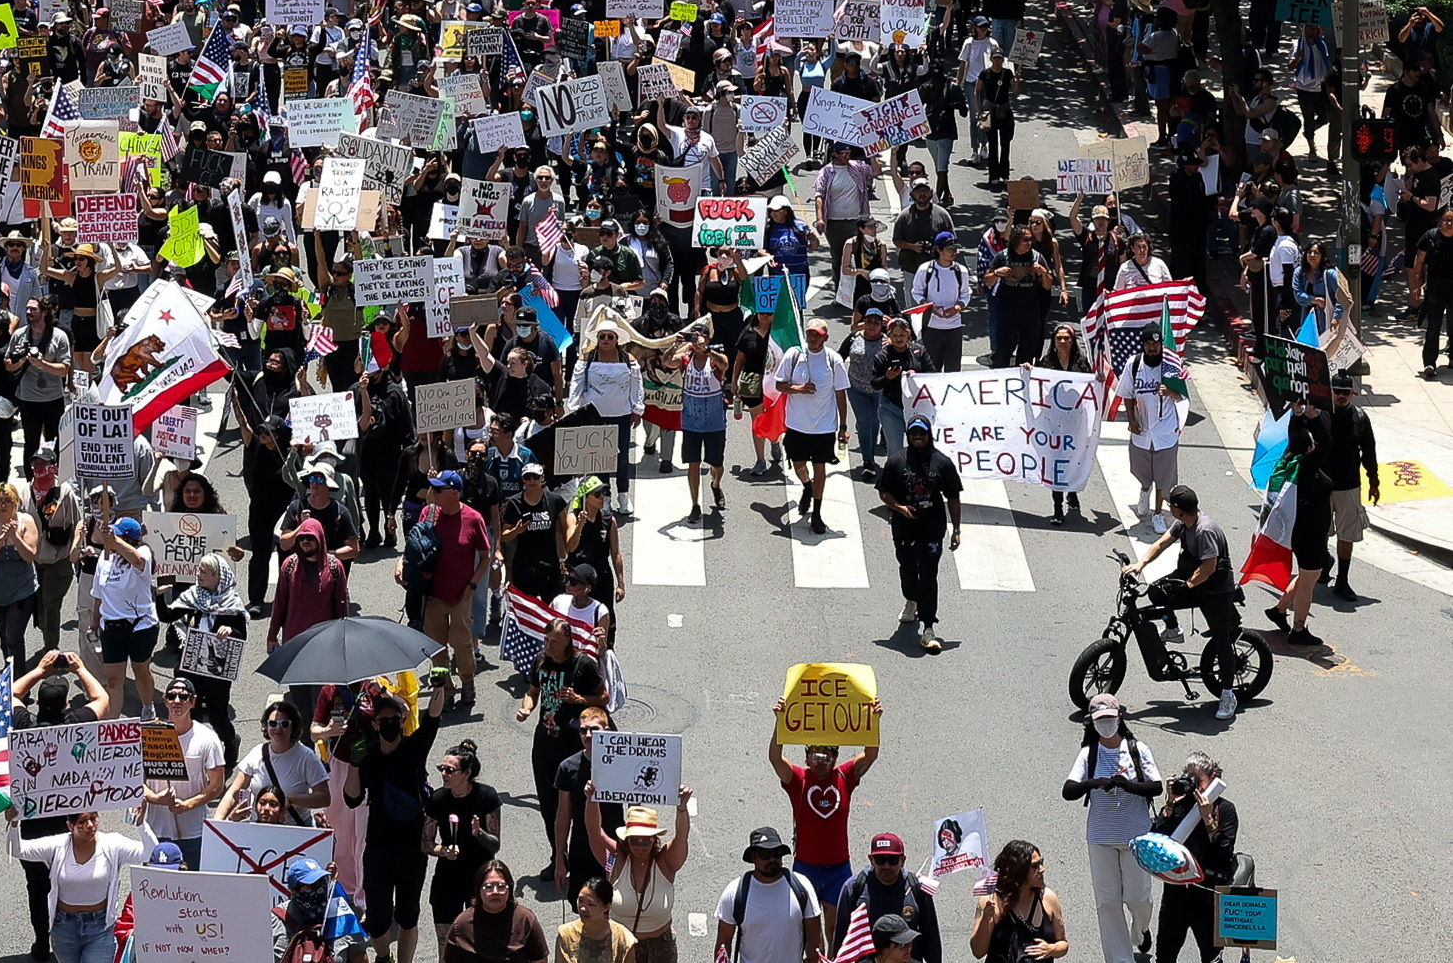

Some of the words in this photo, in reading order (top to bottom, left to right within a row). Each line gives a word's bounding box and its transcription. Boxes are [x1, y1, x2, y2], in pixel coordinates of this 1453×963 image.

[776, 7, 805, 16] becomes
[1288, 4, 1320, 24] ICE
[776, 16, 813, 24] REBELLION
[850, 16, 865, 24] YOUR
[840, 25, 870, 38] OATH
[882, 19, 923, 36] CLOWN
[469, 36, 500, 45] AGAINST
[470, 45, 502, 54] TYRANNY
[146, 56, 156, 64] NO
[144, 85, 158, 97] US
[538, 84, 576, 131] NO
[576, 92, 598, 109] ICE
[743, 97, 754, 109] NO
[770, 98, 786, 111] KINGS
[576, 105, 605, 122] TRUMP
[858, 104, 921, 136] IGNORANCE
[805, 113, 838, 136] Since
[21, 138, 33, 154] NO
[863, 120, 931, 158] IMMIGRANTS
[1384, 128, 1393, 152] 9
[339, 134, 411, 163] SOLIDARITY
[21, 155, 47, 170] KINGS
[70, 161, 117, 178] TYRANT
[190, 152, 224, 174] FUCK
[1058, 160, 1076, 172] WE
[1097, 160, 1112, 172] ALL
[21, 170, 30, 183] IN
[22, 184, 60, 200] AMERICA
[479, 181, 494, 192] NO
[472, 188, 501, 200] KINGS
[77, 194, 136, 213] DEFEND
[698, 199, 756, 221] FUCK
[78, 213, 97, 222] DUE
[98, 211, 137, 221] PROCESS
[463, 218, 472, 228] IN
[78, 223, 111, 233] HEALTH
[113, 221, 137, 232] CARE
[78, 233, 110, 243] MOTHER
[112, 232, 138, 242] EARTH
[358, 260, 394, 273] THEY'RE
[398, 259, 427, 269] EATING
[385, 270, 417, 279] CHECKS!
[359, 282, 390, 291] THEY'RE
[393, 278, 425, 287] EATING
[755, 277, 776, 292] ICE
[382, 287, 431, 301] BALANCES!
[911, 377, 1098, 411] AMERICA
[76, 406, 97, 420] ICE
[102, 408, 129, 421] OUT
[418, 400, 449, 415] Illegal
[158, 416, 185, 429] LIBERTY
[78, 423, 98, 438] OF
[102, 424, 128, 438] LA!
[156, 431, 177, 443] JUSTICE
[180, 436, 191, 446] FOR
[159, 440, 167, 448] ALL
[561, 429, 616, 450] FUCK
[971, 426, 1005, 441] ARE
[1019, 426, 1077, 451] YOUR
[81, 442, 101, 453] END
[104, 444, 124, 453] THE
[81, 452, 126, 463] VIOLENT
[77, 463, 109, 471] CRIMINAL
[958, 450, 1070, 486] PEOPLE
[527, 520, 552, 531] OBAMA
[186, 535, 207, 548] THE
[800, 678, 848, 698] ICE
[784, 701, 827, 732] GET
[832, 702, 875, 733] OUT
[10, 733, 46, 750] PARA
[57, 728, 84, 743] MIS
[98, 723, 141, 742] PADRES
[610, 736, 631, 745] CAN
[638, 737, 666, 747] HEAR
[605, 746, 626, 755] THE
[629, 746, 667, 758] DRUMS
[602, 755, 615, 764] OF
[11, 777, 37, 794] SIN
[52, 770, 90, 787] NADA
[124, 762, 142, 779] ME
[148, 768, 184, 776] NOW!!!
[24, 791, 96, 816] DIERON
[105, 786, 143, 803] TODO
[178, 908, 218, 918] starts
[165, 924, 184, 934] with
[155, 944, 172, 953] NOT
[177, 945, 194, 953] NOW
[201, 946, 230, 955] WHEN?
